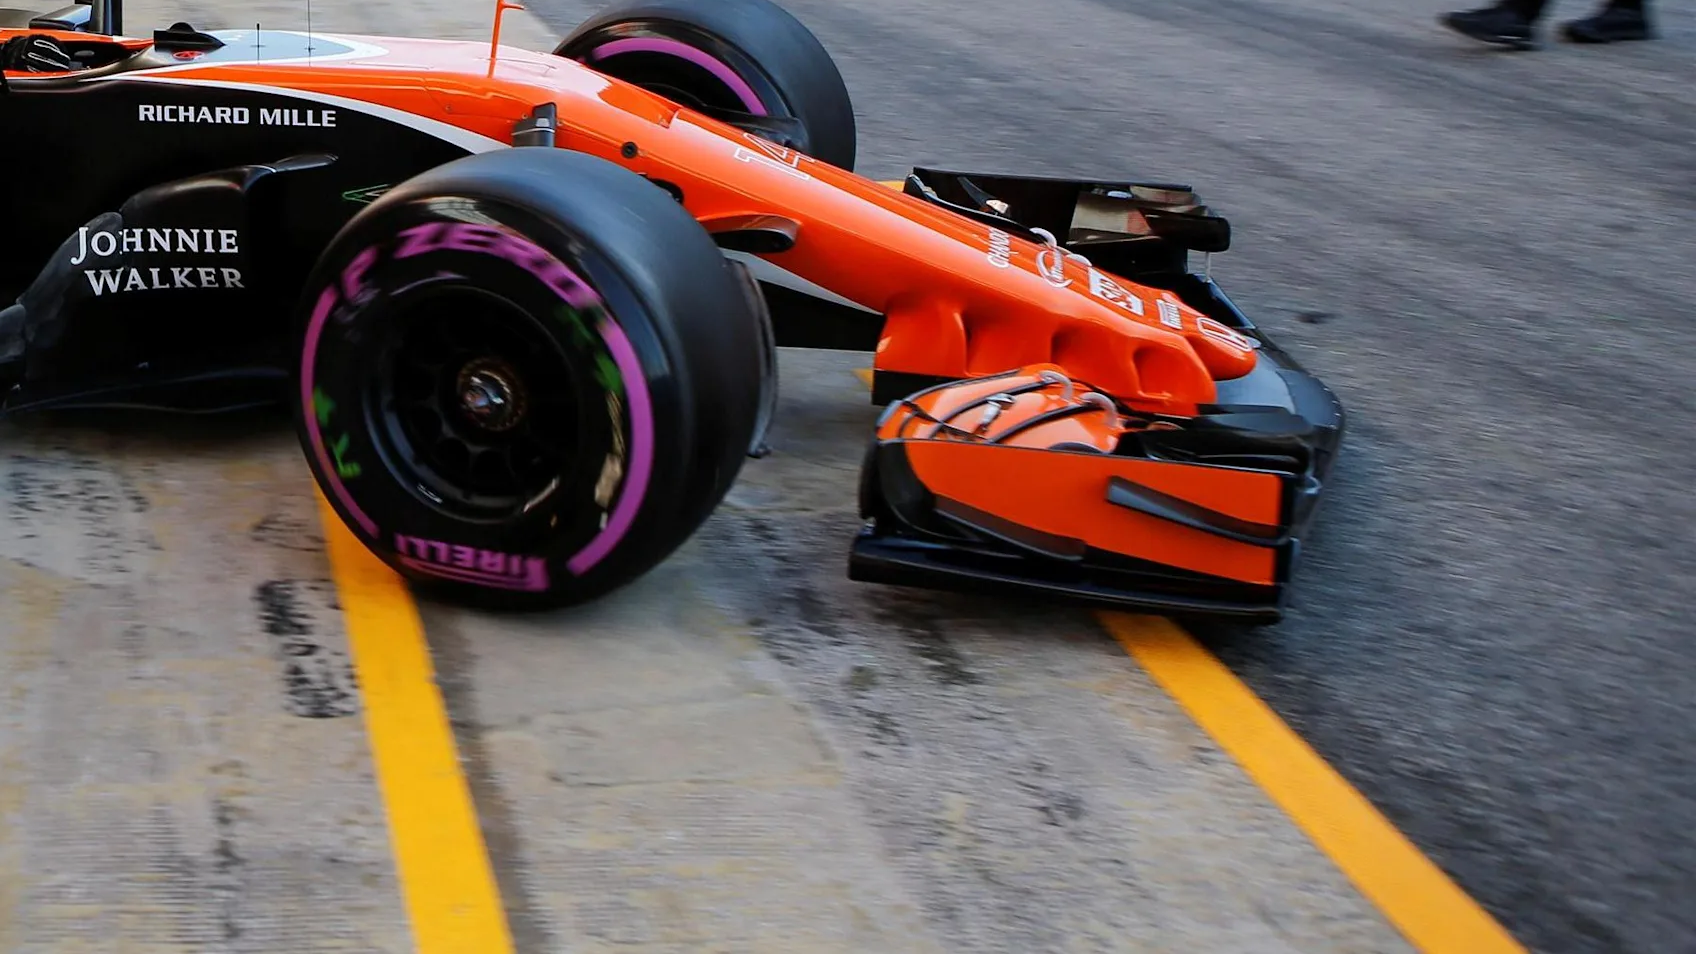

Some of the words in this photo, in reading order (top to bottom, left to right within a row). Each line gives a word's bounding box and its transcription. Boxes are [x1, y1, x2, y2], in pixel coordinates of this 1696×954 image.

[138, 104, 250, 125] RICHARD
[259, 108, 337, 128] MILLE
[70, 226, 239, 265] JOHNNIE
[84, 267, 246, 296] WALKER
[394, 532, 550, 592] PIRELLI
